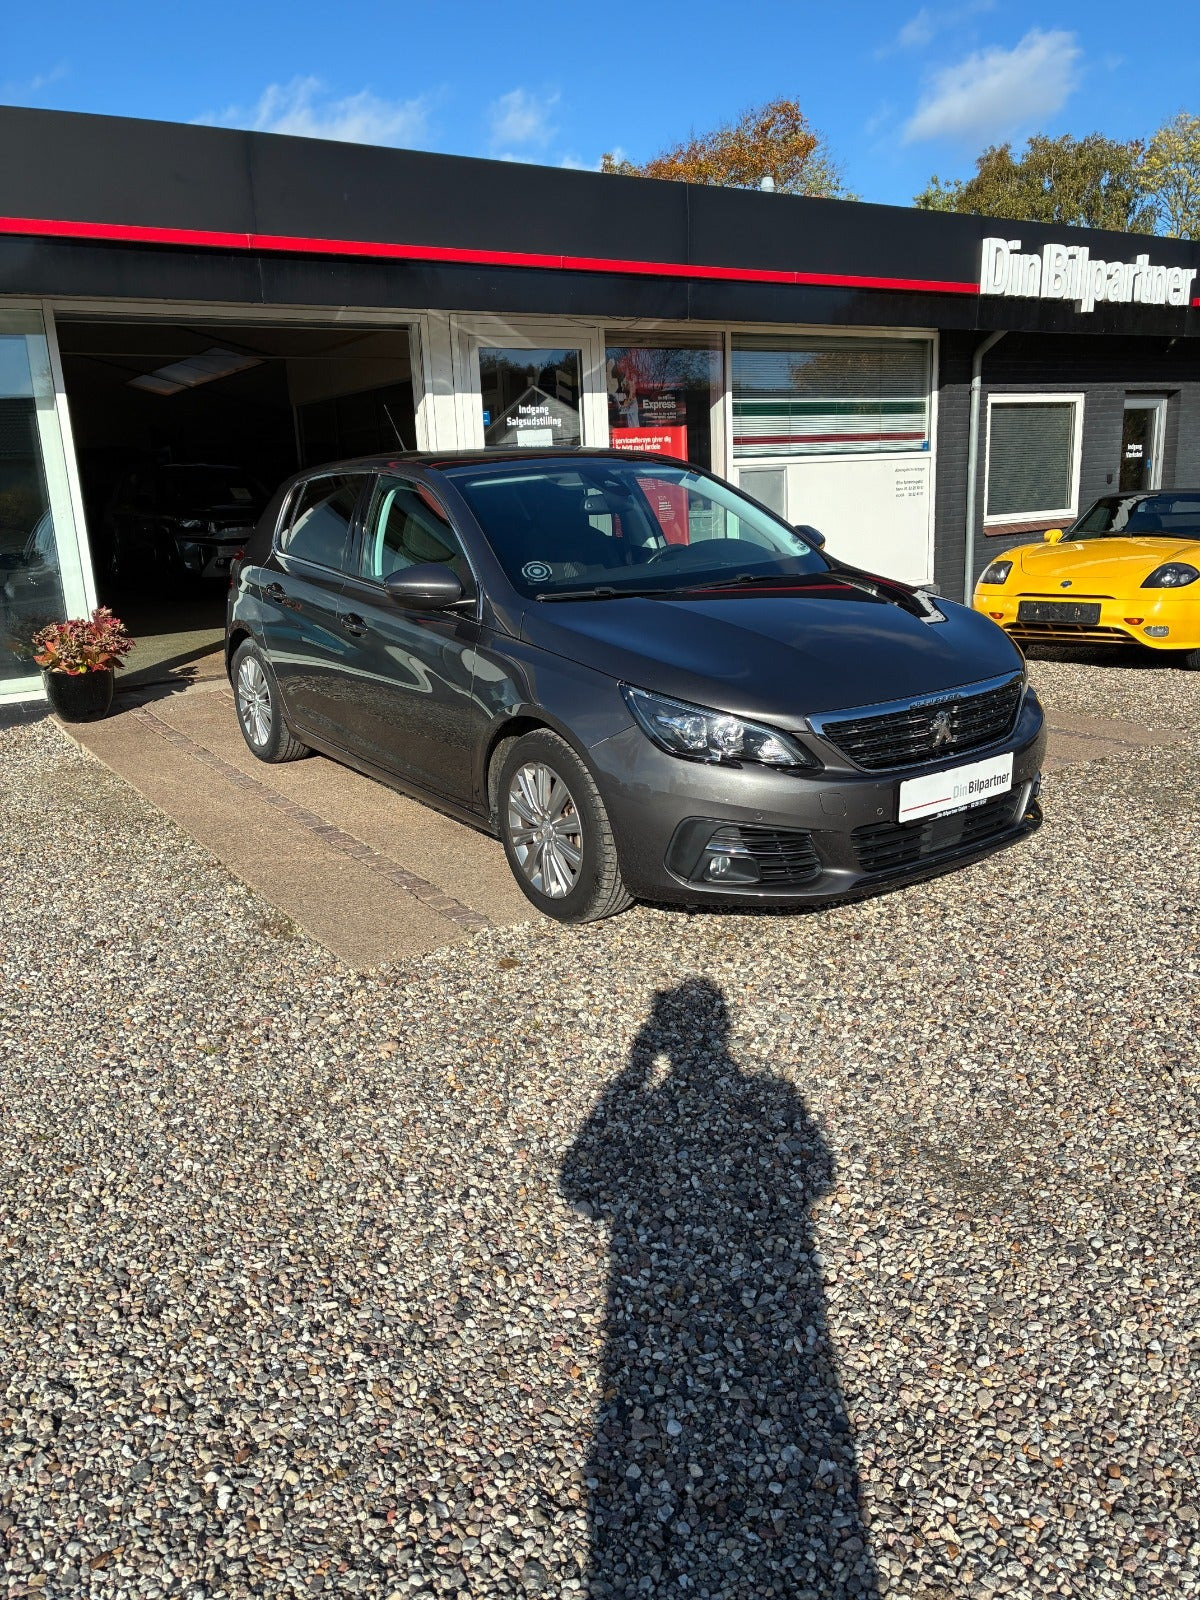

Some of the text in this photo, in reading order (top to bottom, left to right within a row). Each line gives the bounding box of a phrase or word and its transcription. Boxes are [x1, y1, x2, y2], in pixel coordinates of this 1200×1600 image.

[518, 404, 550, 416] Indgang
[642, 399, 676, 411] Express
[506, 416, 562, 428] Salgsudstilling
